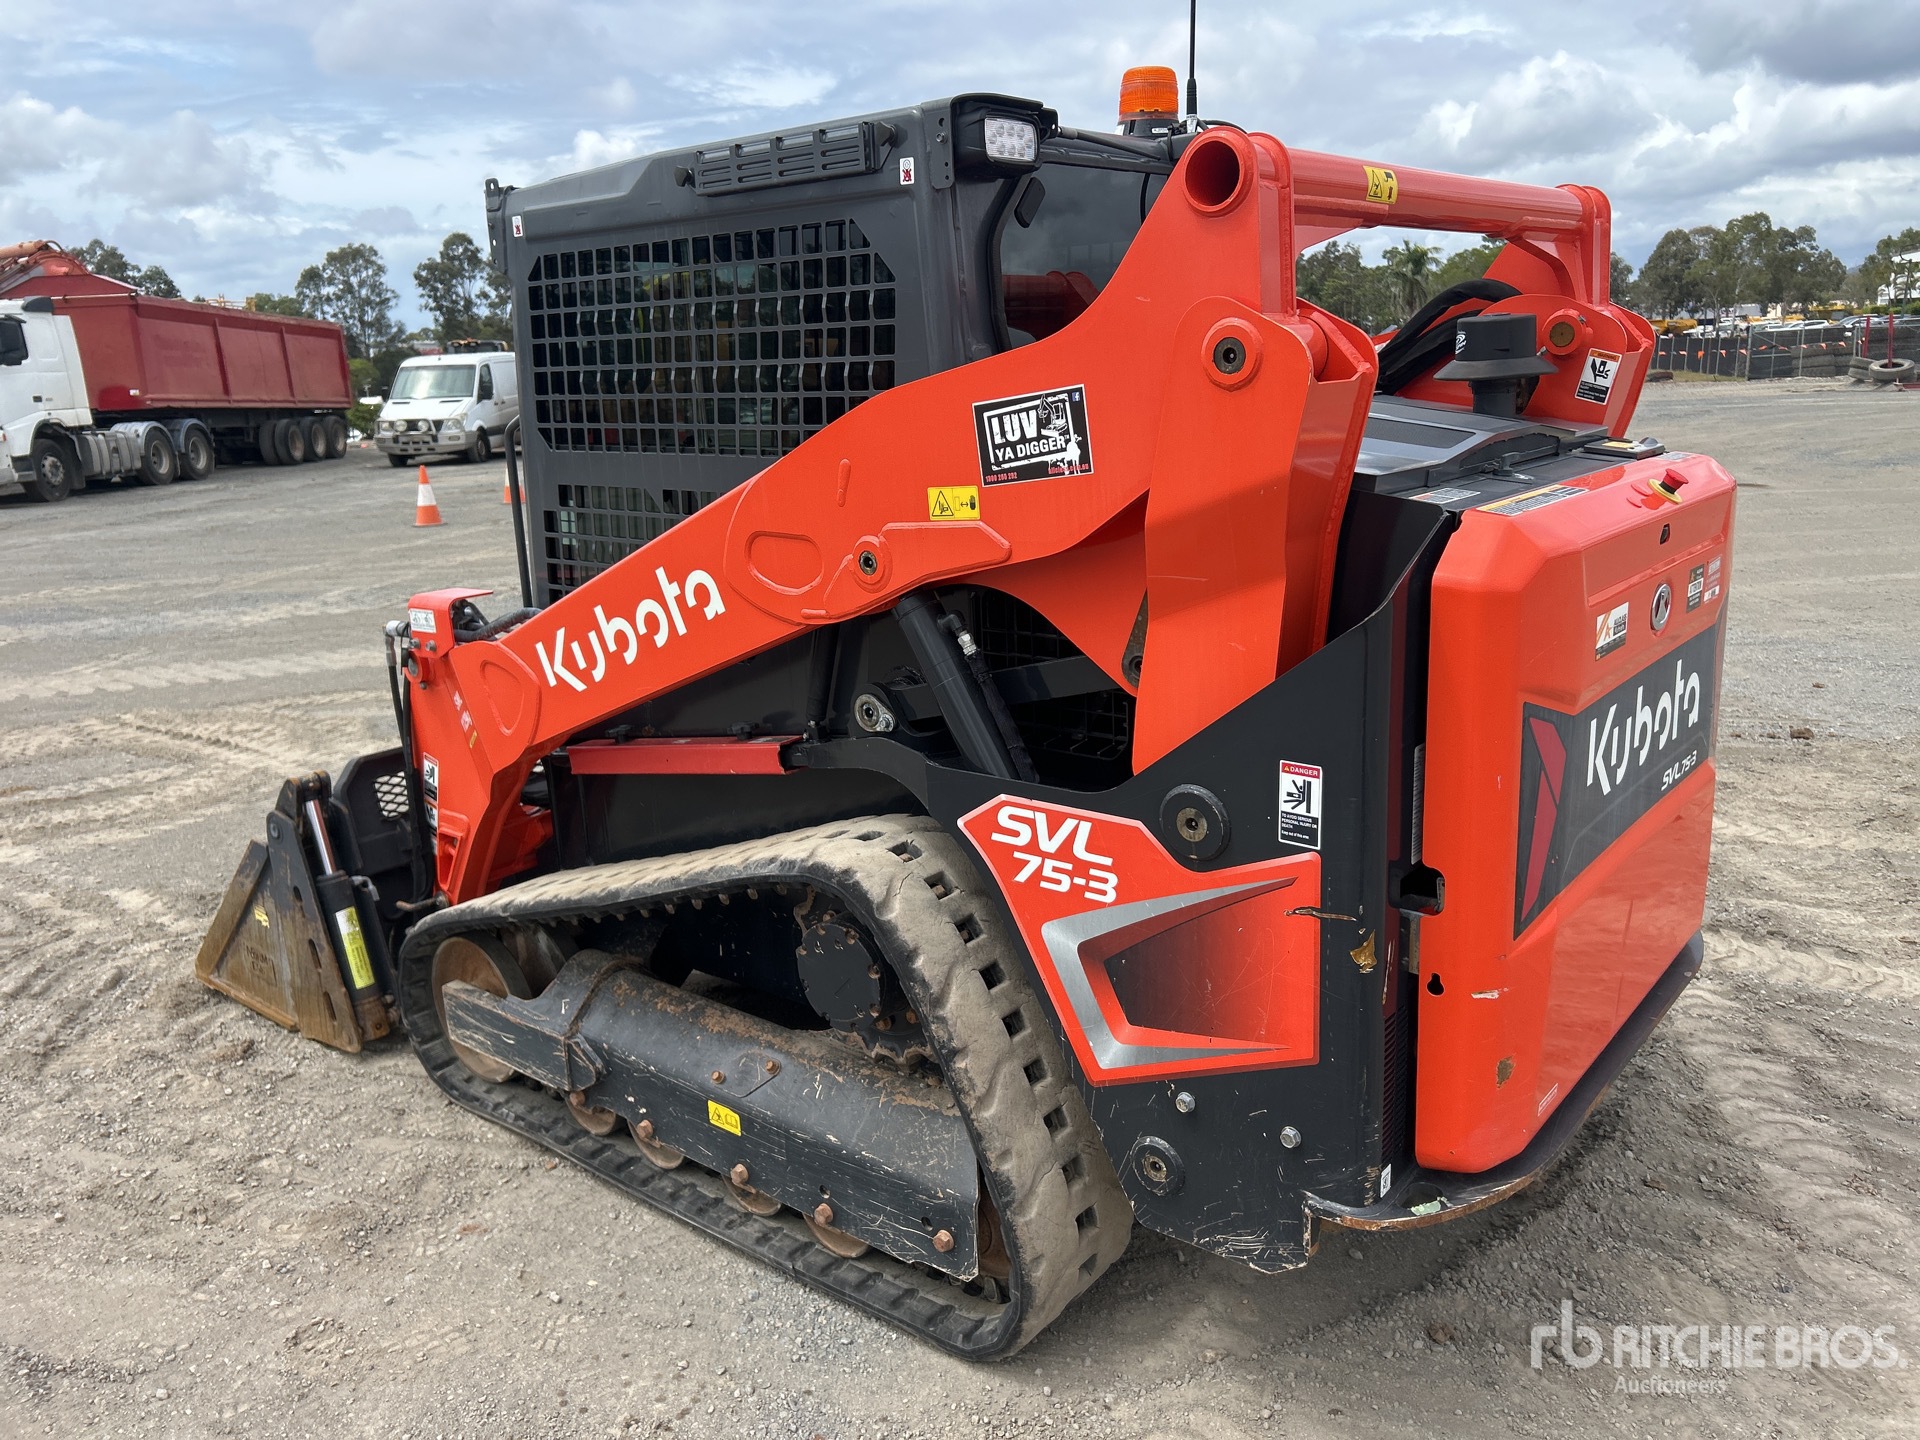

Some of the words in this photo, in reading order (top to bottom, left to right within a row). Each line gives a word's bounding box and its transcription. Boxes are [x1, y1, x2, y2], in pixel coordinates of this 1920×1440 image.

[991, 409, 1037, 444] LUV
[995, 447, 1014, 461] YA
[535, 566, 725, 692] Kubota
[1587, 659, 1700, 796] Kubota
[1290, 766, 1318, 776] DANGER
[991, 805, 1114, 866] SVL
[1013, 851, 1119, 903] 75-3
